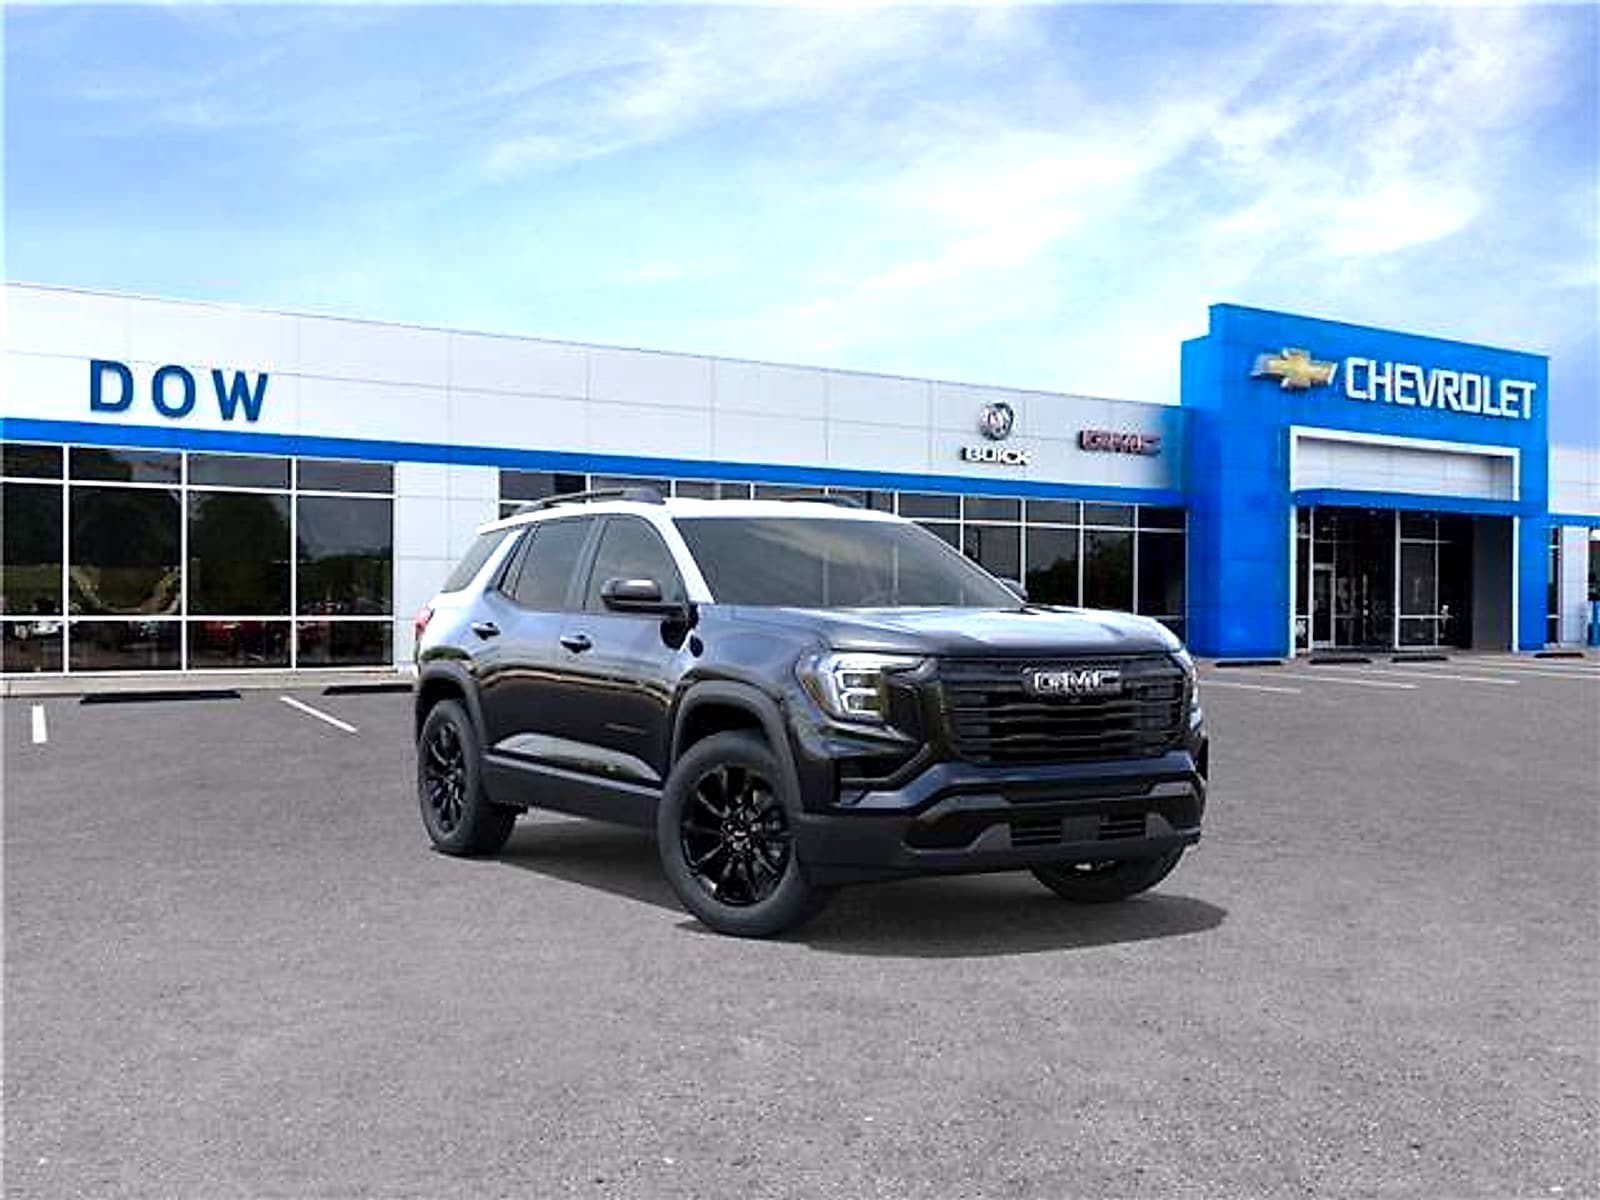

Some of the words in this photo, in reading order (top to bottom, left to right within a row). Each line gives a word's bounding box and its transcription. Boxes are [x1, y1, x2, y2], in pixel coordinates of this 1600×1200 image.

[90, 359, 269, 422] DOW
[1344, 356, 1537, 420] CHEVROLET
[962, 446, 1031, 465] BUICK
[1024, 668, 1121, 696] GMC
